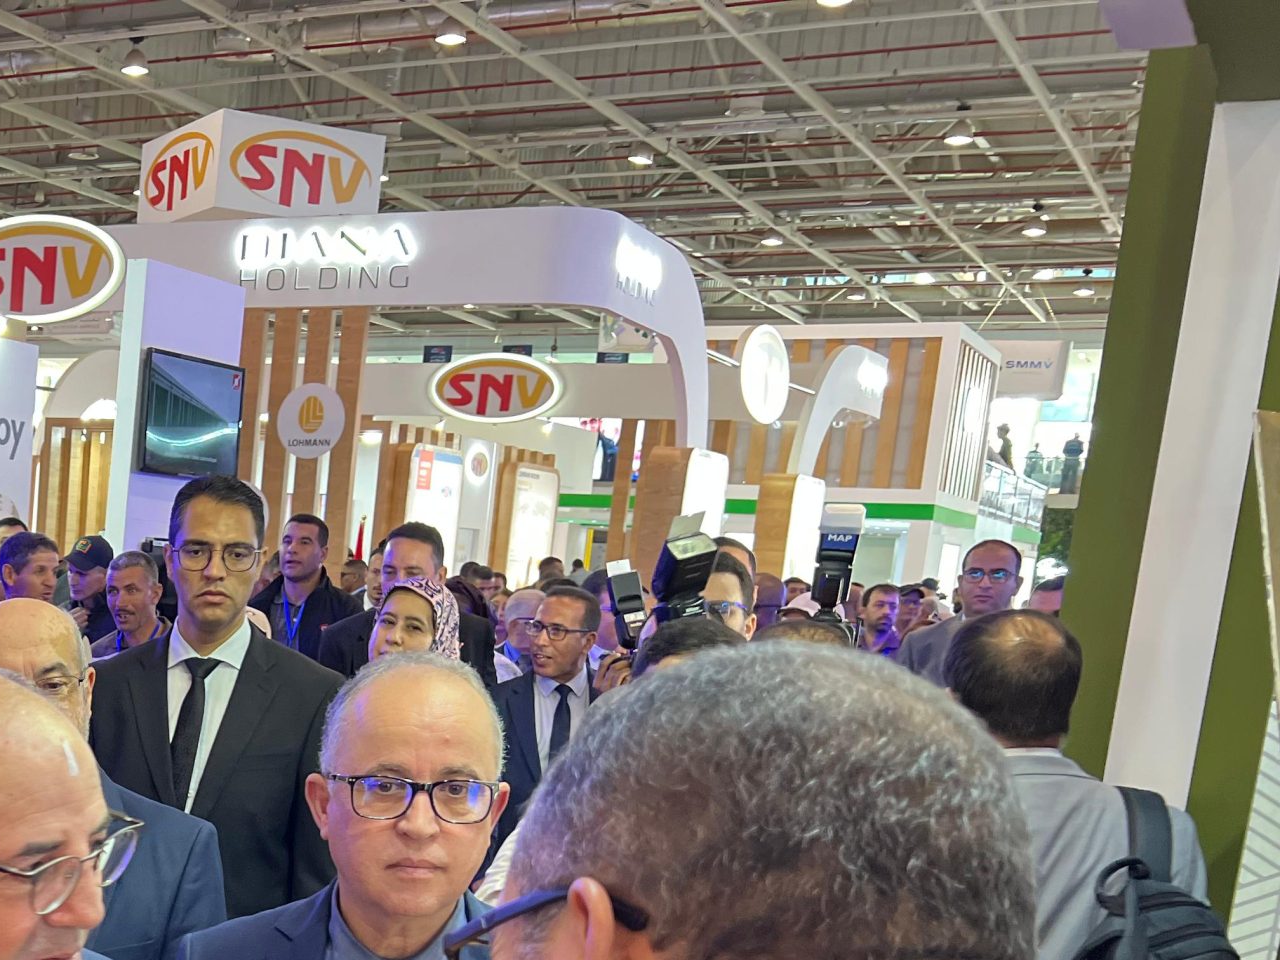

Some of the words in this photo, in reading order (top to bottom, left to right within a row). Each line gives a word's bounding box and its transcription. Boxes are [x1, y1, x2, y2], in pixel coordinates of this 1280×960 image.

[148, 140, 211, 212] SNV
[240, 143, 368, 208] SNV
[239, 264, 410, 291] HOLDING
[1005, 360, 1054, 369] SMMV
[446, 373, 549, 416] SNV
[287, 439, 331, 448] LOHMANN
[827, 533, 853, 543] MAP
